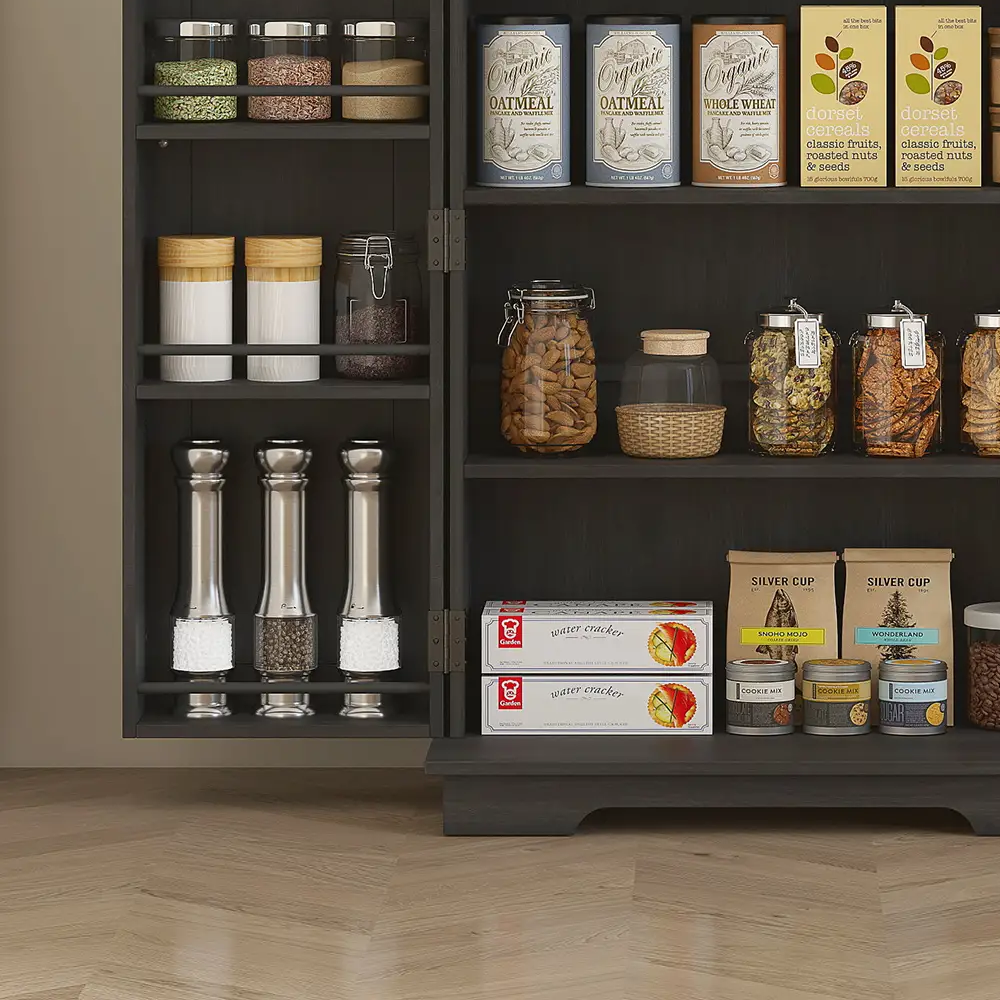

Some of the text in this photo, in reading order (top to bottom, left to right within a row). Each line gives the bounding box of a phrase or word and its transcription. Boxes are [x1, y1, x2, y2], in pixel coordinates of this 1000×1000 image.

[487, 47, 552, 95] Organic
[598, 47, 663, 94] Organic
[704, 47, 770, 94] Organic
[490, 96, 553, 110] OATMEAL
[600, 96, 664, 110] OATMEAL
[704, 99, 776, 109] WHOLE WHEAT
[806, 106, 863, 120] dorset
[901, 106, 958, 120] dorset
[806, 123, 870, 137] cereals
[901, 123, 965, 137] cereals
[807, 139, 881, 150] classic fruits,
[902, 139, 976, 150] classic fruits,
[807, 151, 848, 159] roasted
[902, 151, 943, 159] roasted
[806, 162, 850, 171] & seeds
[901, 162, 945, 171] & seeds
[751, 577, 815, 586] SILVER CUP
[867, 577, 930, 586] SILVER CUP
[551, 624, 624, 638] water cracker
[551, 685, 624, 699] water cracker
